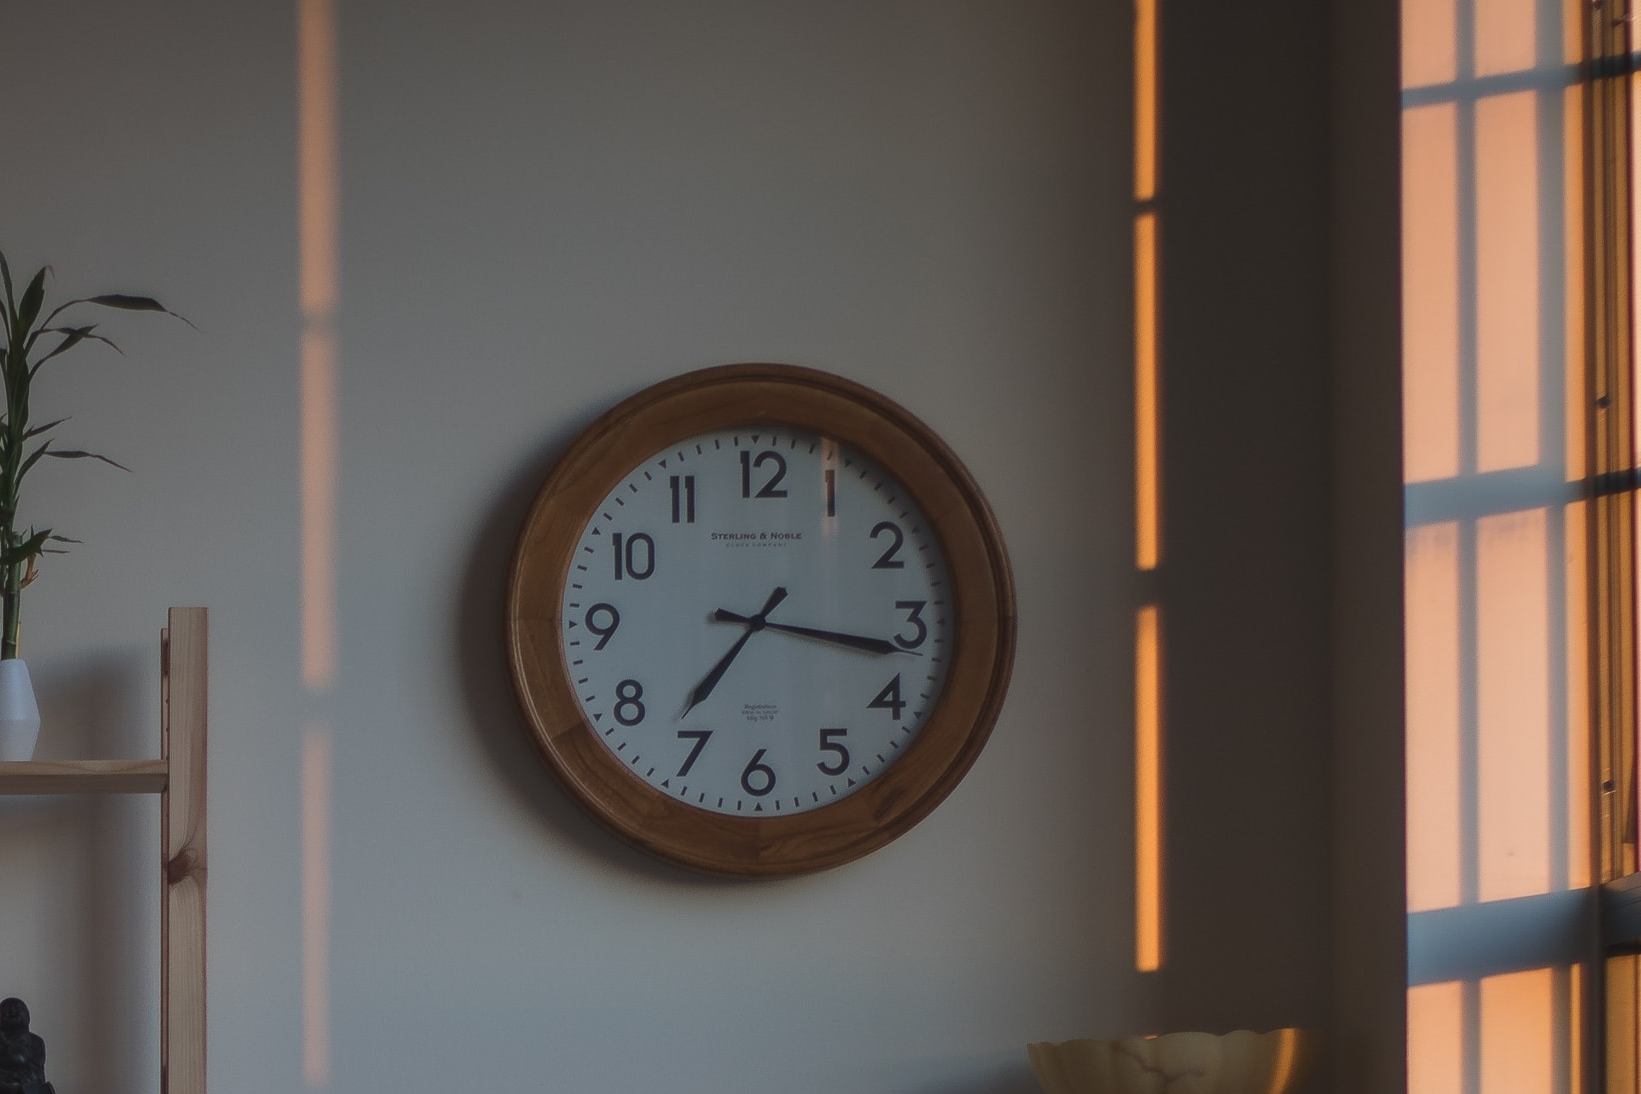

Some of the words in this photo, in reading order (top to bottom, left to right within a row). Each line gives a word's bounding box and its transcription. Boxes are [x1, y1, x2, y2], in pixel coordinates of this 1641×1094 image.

[740, 451, 787, 497] 12
[826, 470, 834, 516] 1
[670, 476, 695, 523] 11
[613, 533, 654, 580] 10
[871, 522, 904, 568] 2
[586, 604, 620, 650] 9
[894, 601, 926, 649] 3
[614, 680, 645, 726] 8
[867, 674, 906, 719] 4
[677, 731, 712, 775] 7
[741, 749, 775, 795] 6
[817, 729, 849, 775] 5
